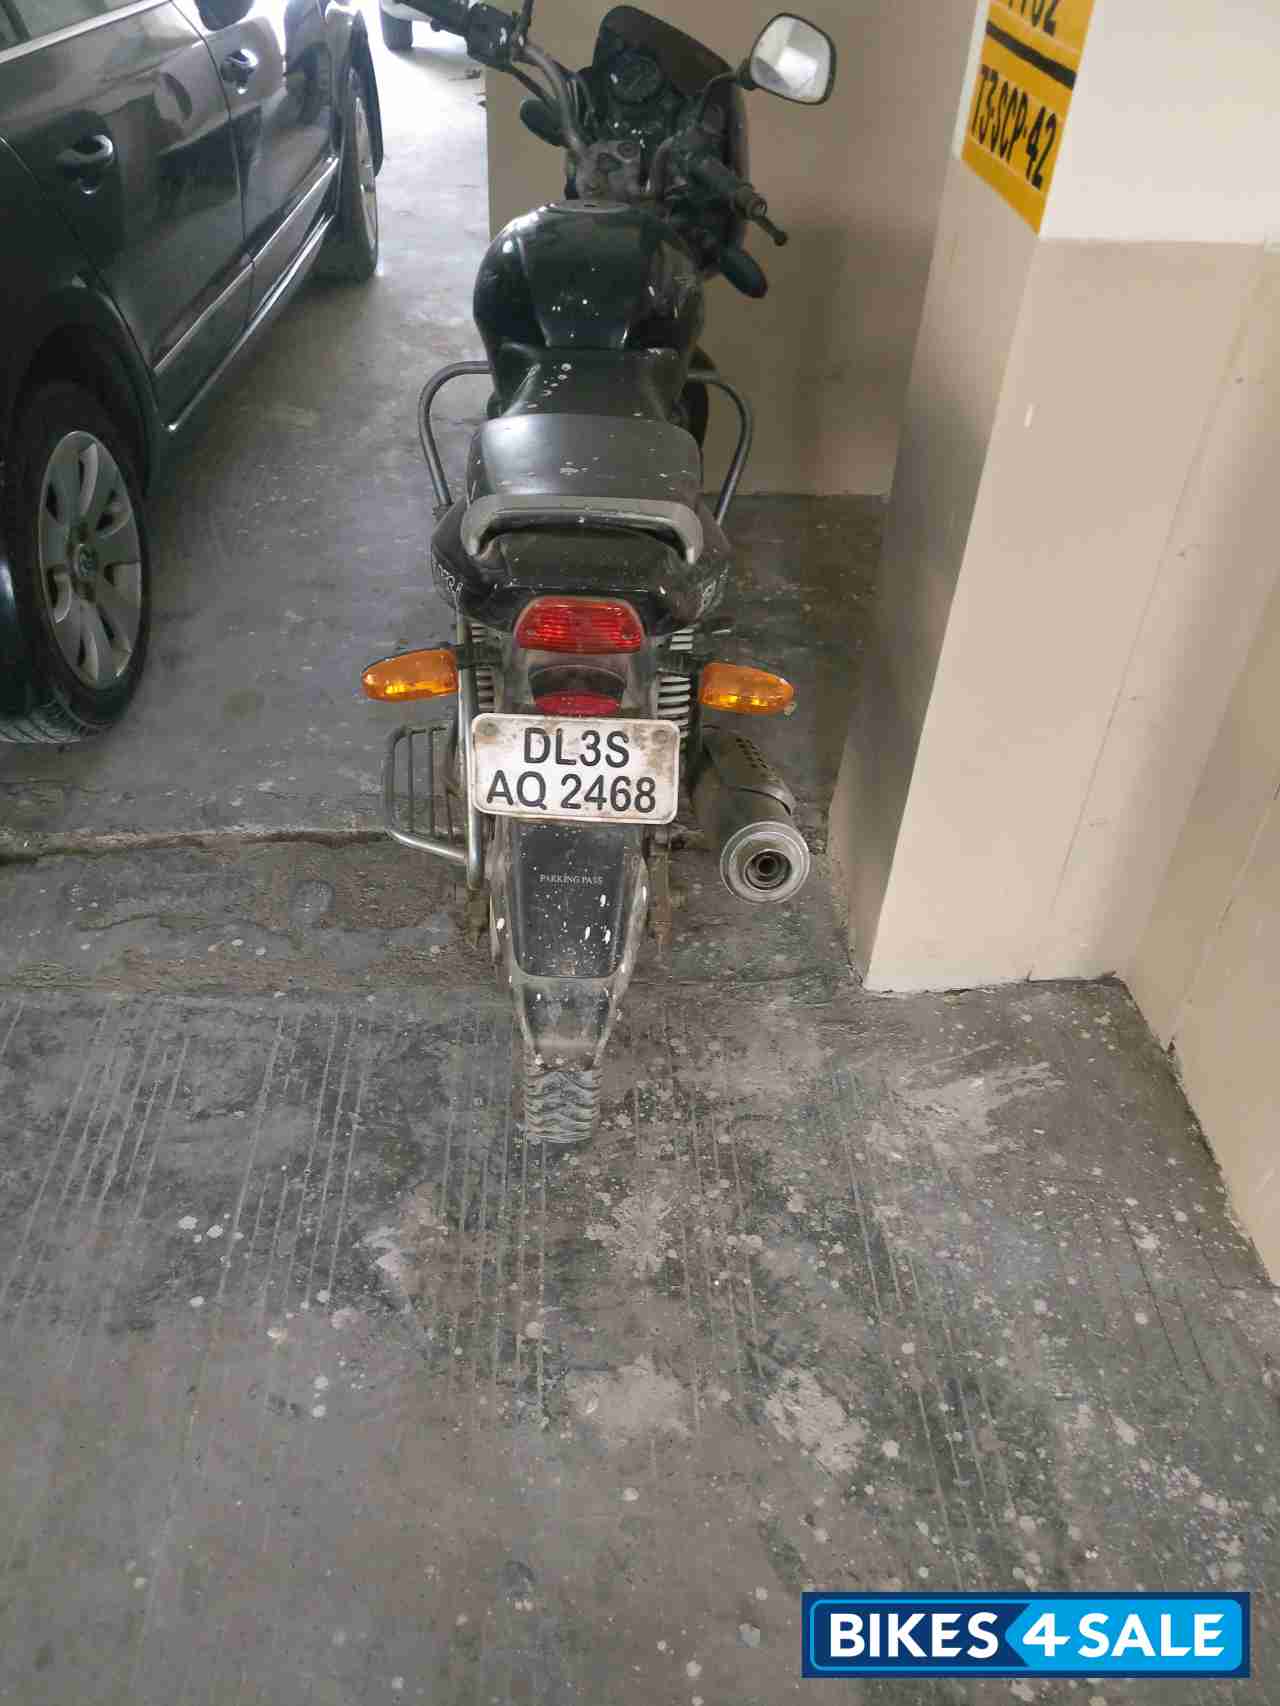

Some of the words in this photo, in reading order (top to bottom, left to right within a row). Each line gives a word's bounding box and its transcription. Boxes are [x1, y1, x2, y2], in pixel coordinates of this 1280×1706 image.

[523, 727, 630, 768] DL3S
[486, 769, 547, 811] AQ
[560, 773, 656, 813] 2468
